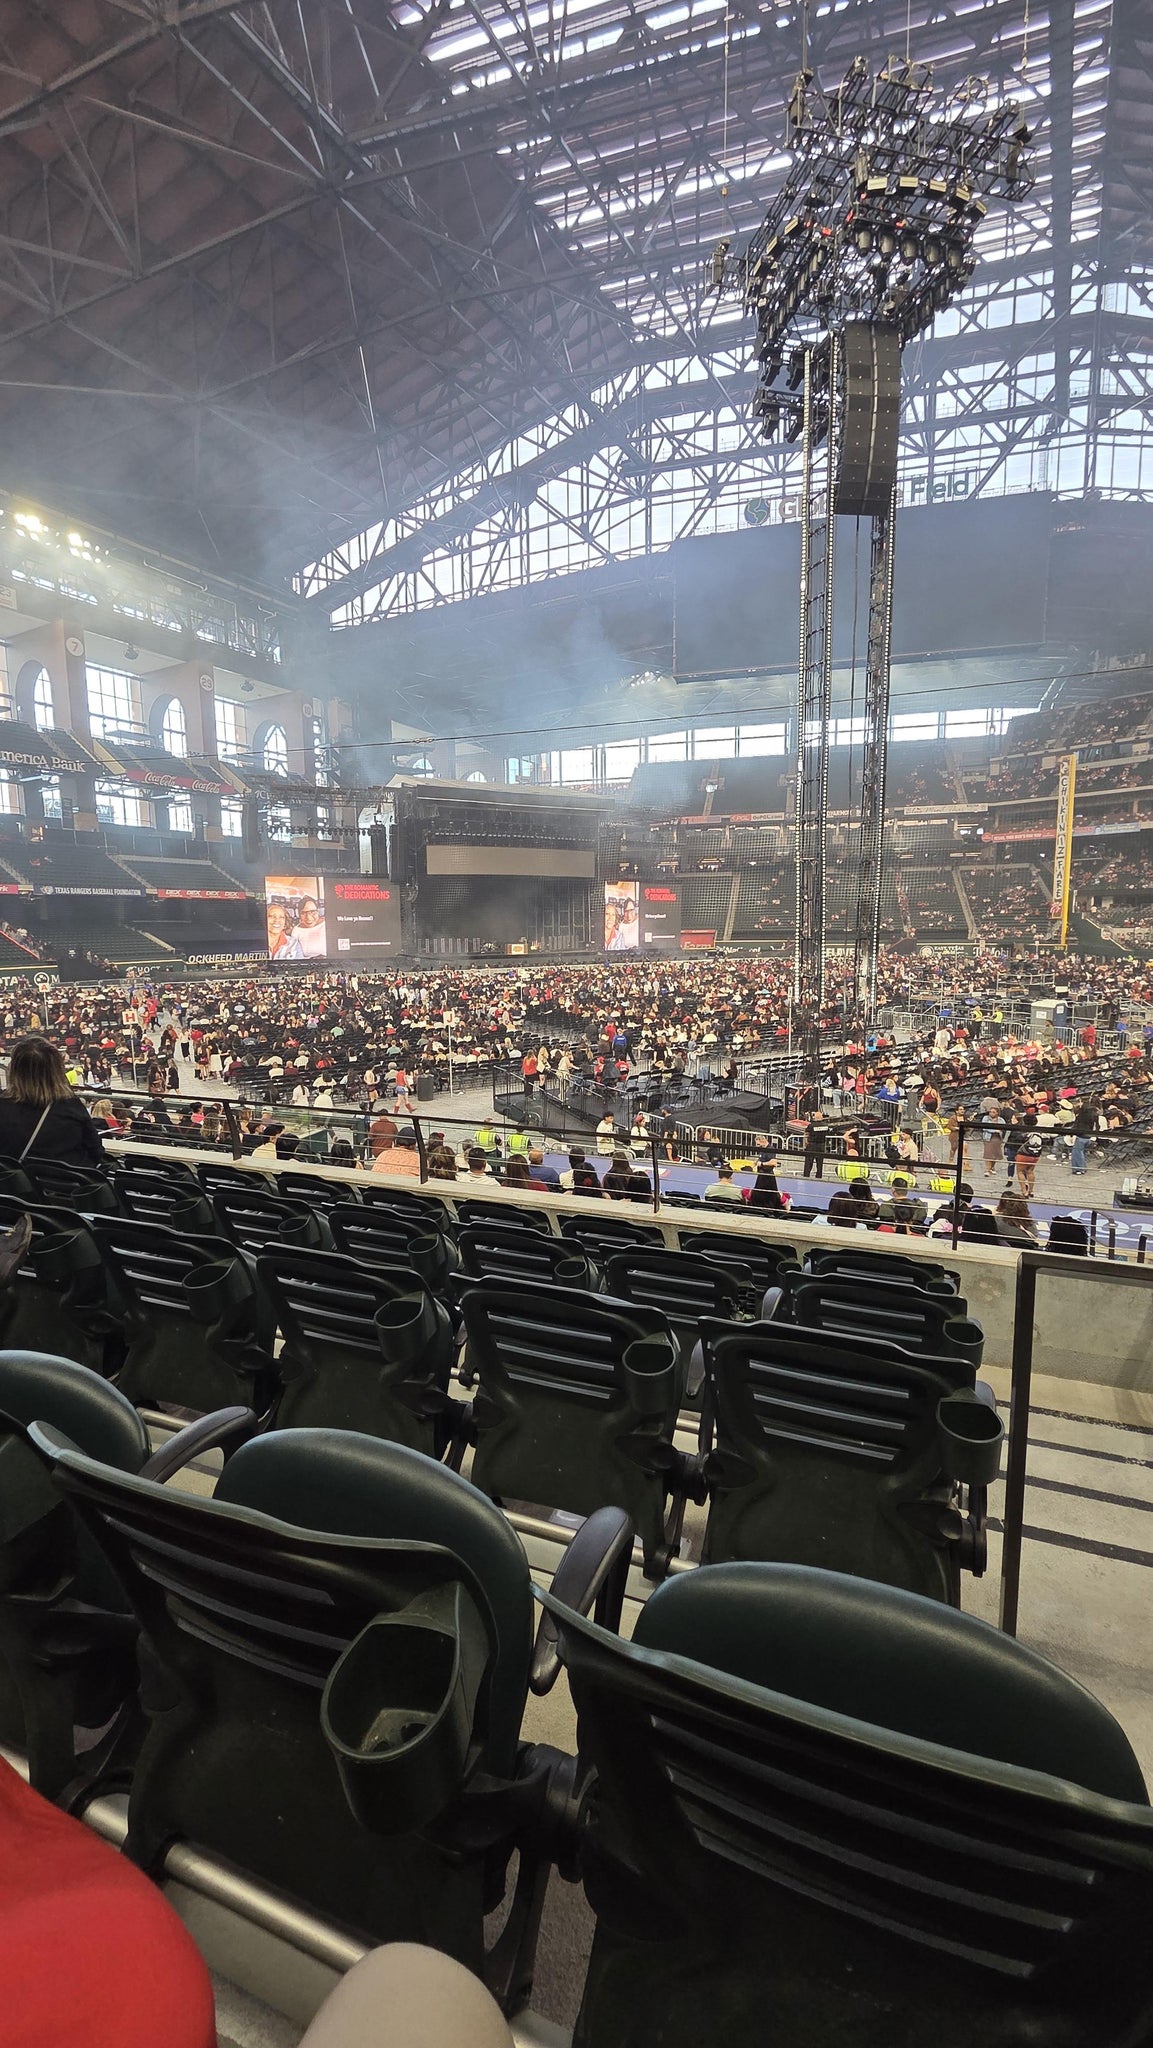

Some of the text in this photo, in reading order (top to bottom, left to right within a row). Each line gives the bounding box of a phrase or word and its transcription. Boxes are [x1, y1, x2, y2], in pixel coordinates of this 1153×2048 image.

[911, 471, 969, 502] Field
[71, 641, 78, 651] 7
[51, 756, 86, 772] Bank
[1058, 777, 1068, 832] CHIKIN
[70, 887, 92, 895] RANGERS
[114, 888, 141, 896] FOUNDATION
[344, 891, 390, 899] DEDICATIONS
[188, 952, 268, 963] OCKHEED MARTIN
[125, 1013, 135, 1022] H
[447, 1013, 452, 1023] J
